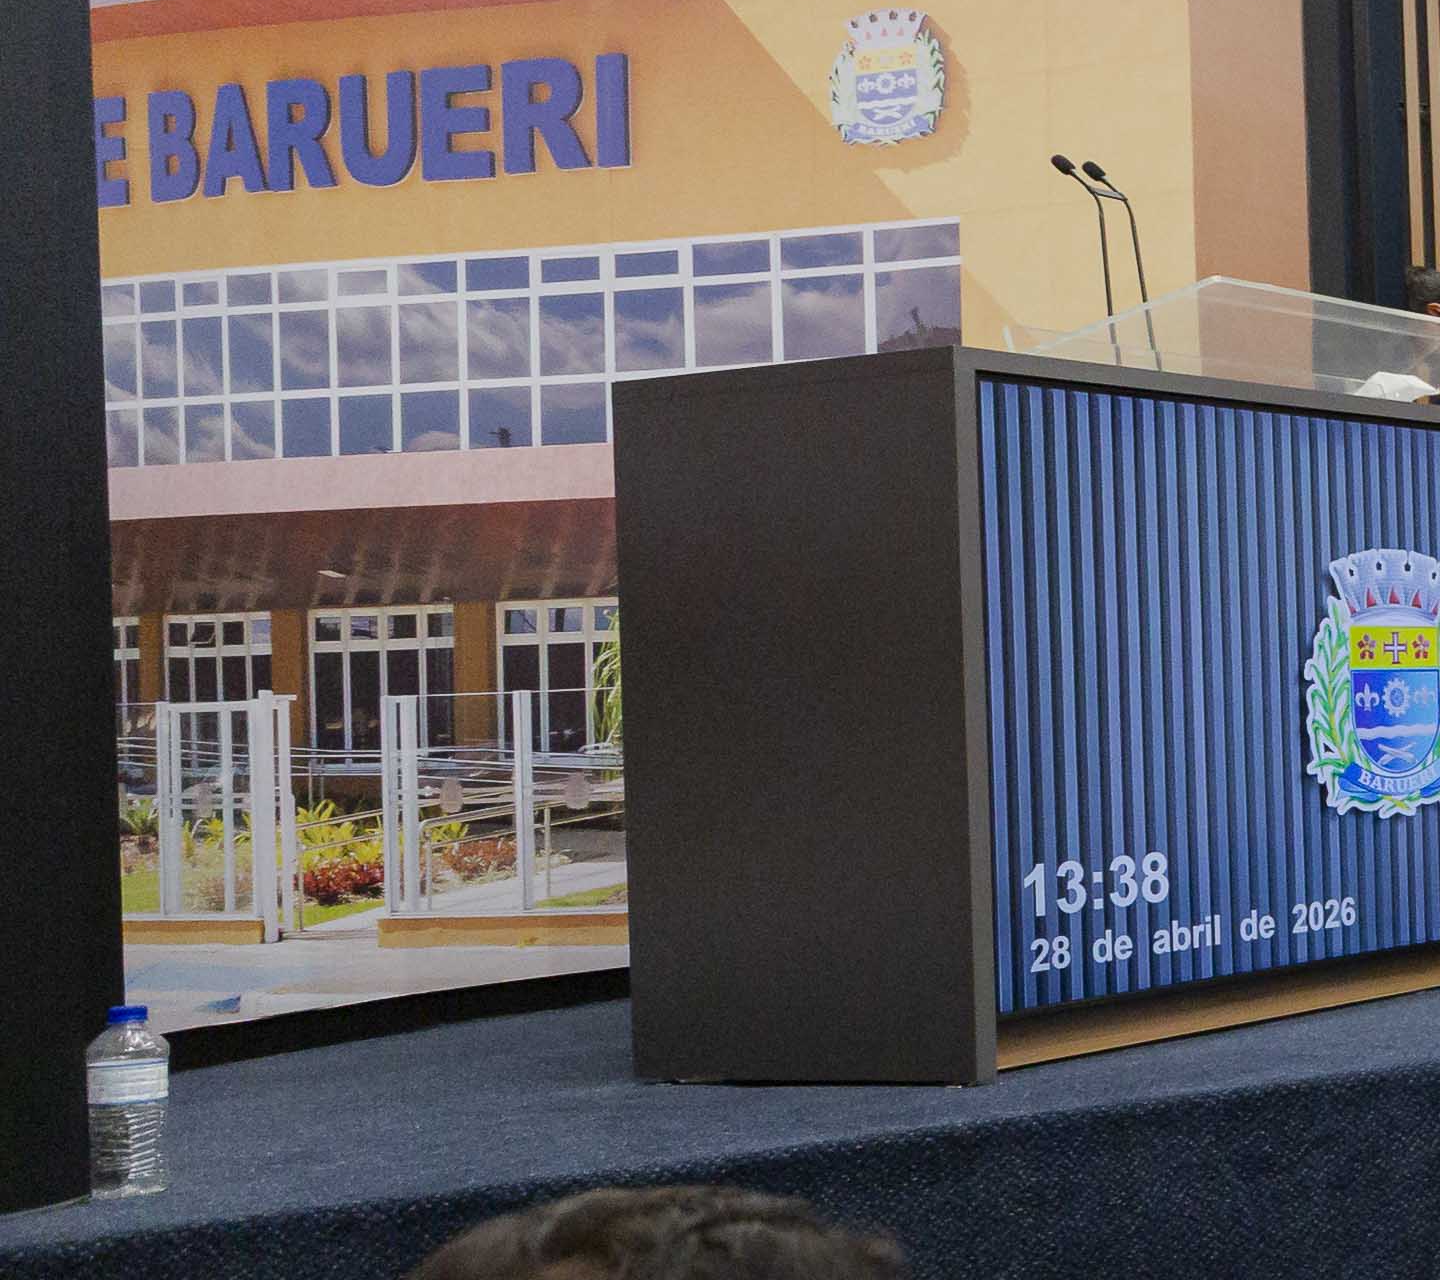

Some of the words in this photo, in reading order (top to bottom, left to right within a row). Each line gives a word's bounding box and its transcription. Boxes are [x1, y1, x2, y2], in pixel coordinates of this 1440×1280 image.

[147, 53, 632, 204] BARUERI
[1023, 852, 1170, 917] 13:38
[1030, 935, 1071, 973] 28
[1092, 929, 1133, 963] de
[1152, 914, 1221, 955] abril
[1239, 909, 1275, 942] de
[1291, 897, 1356, 934] 2026
